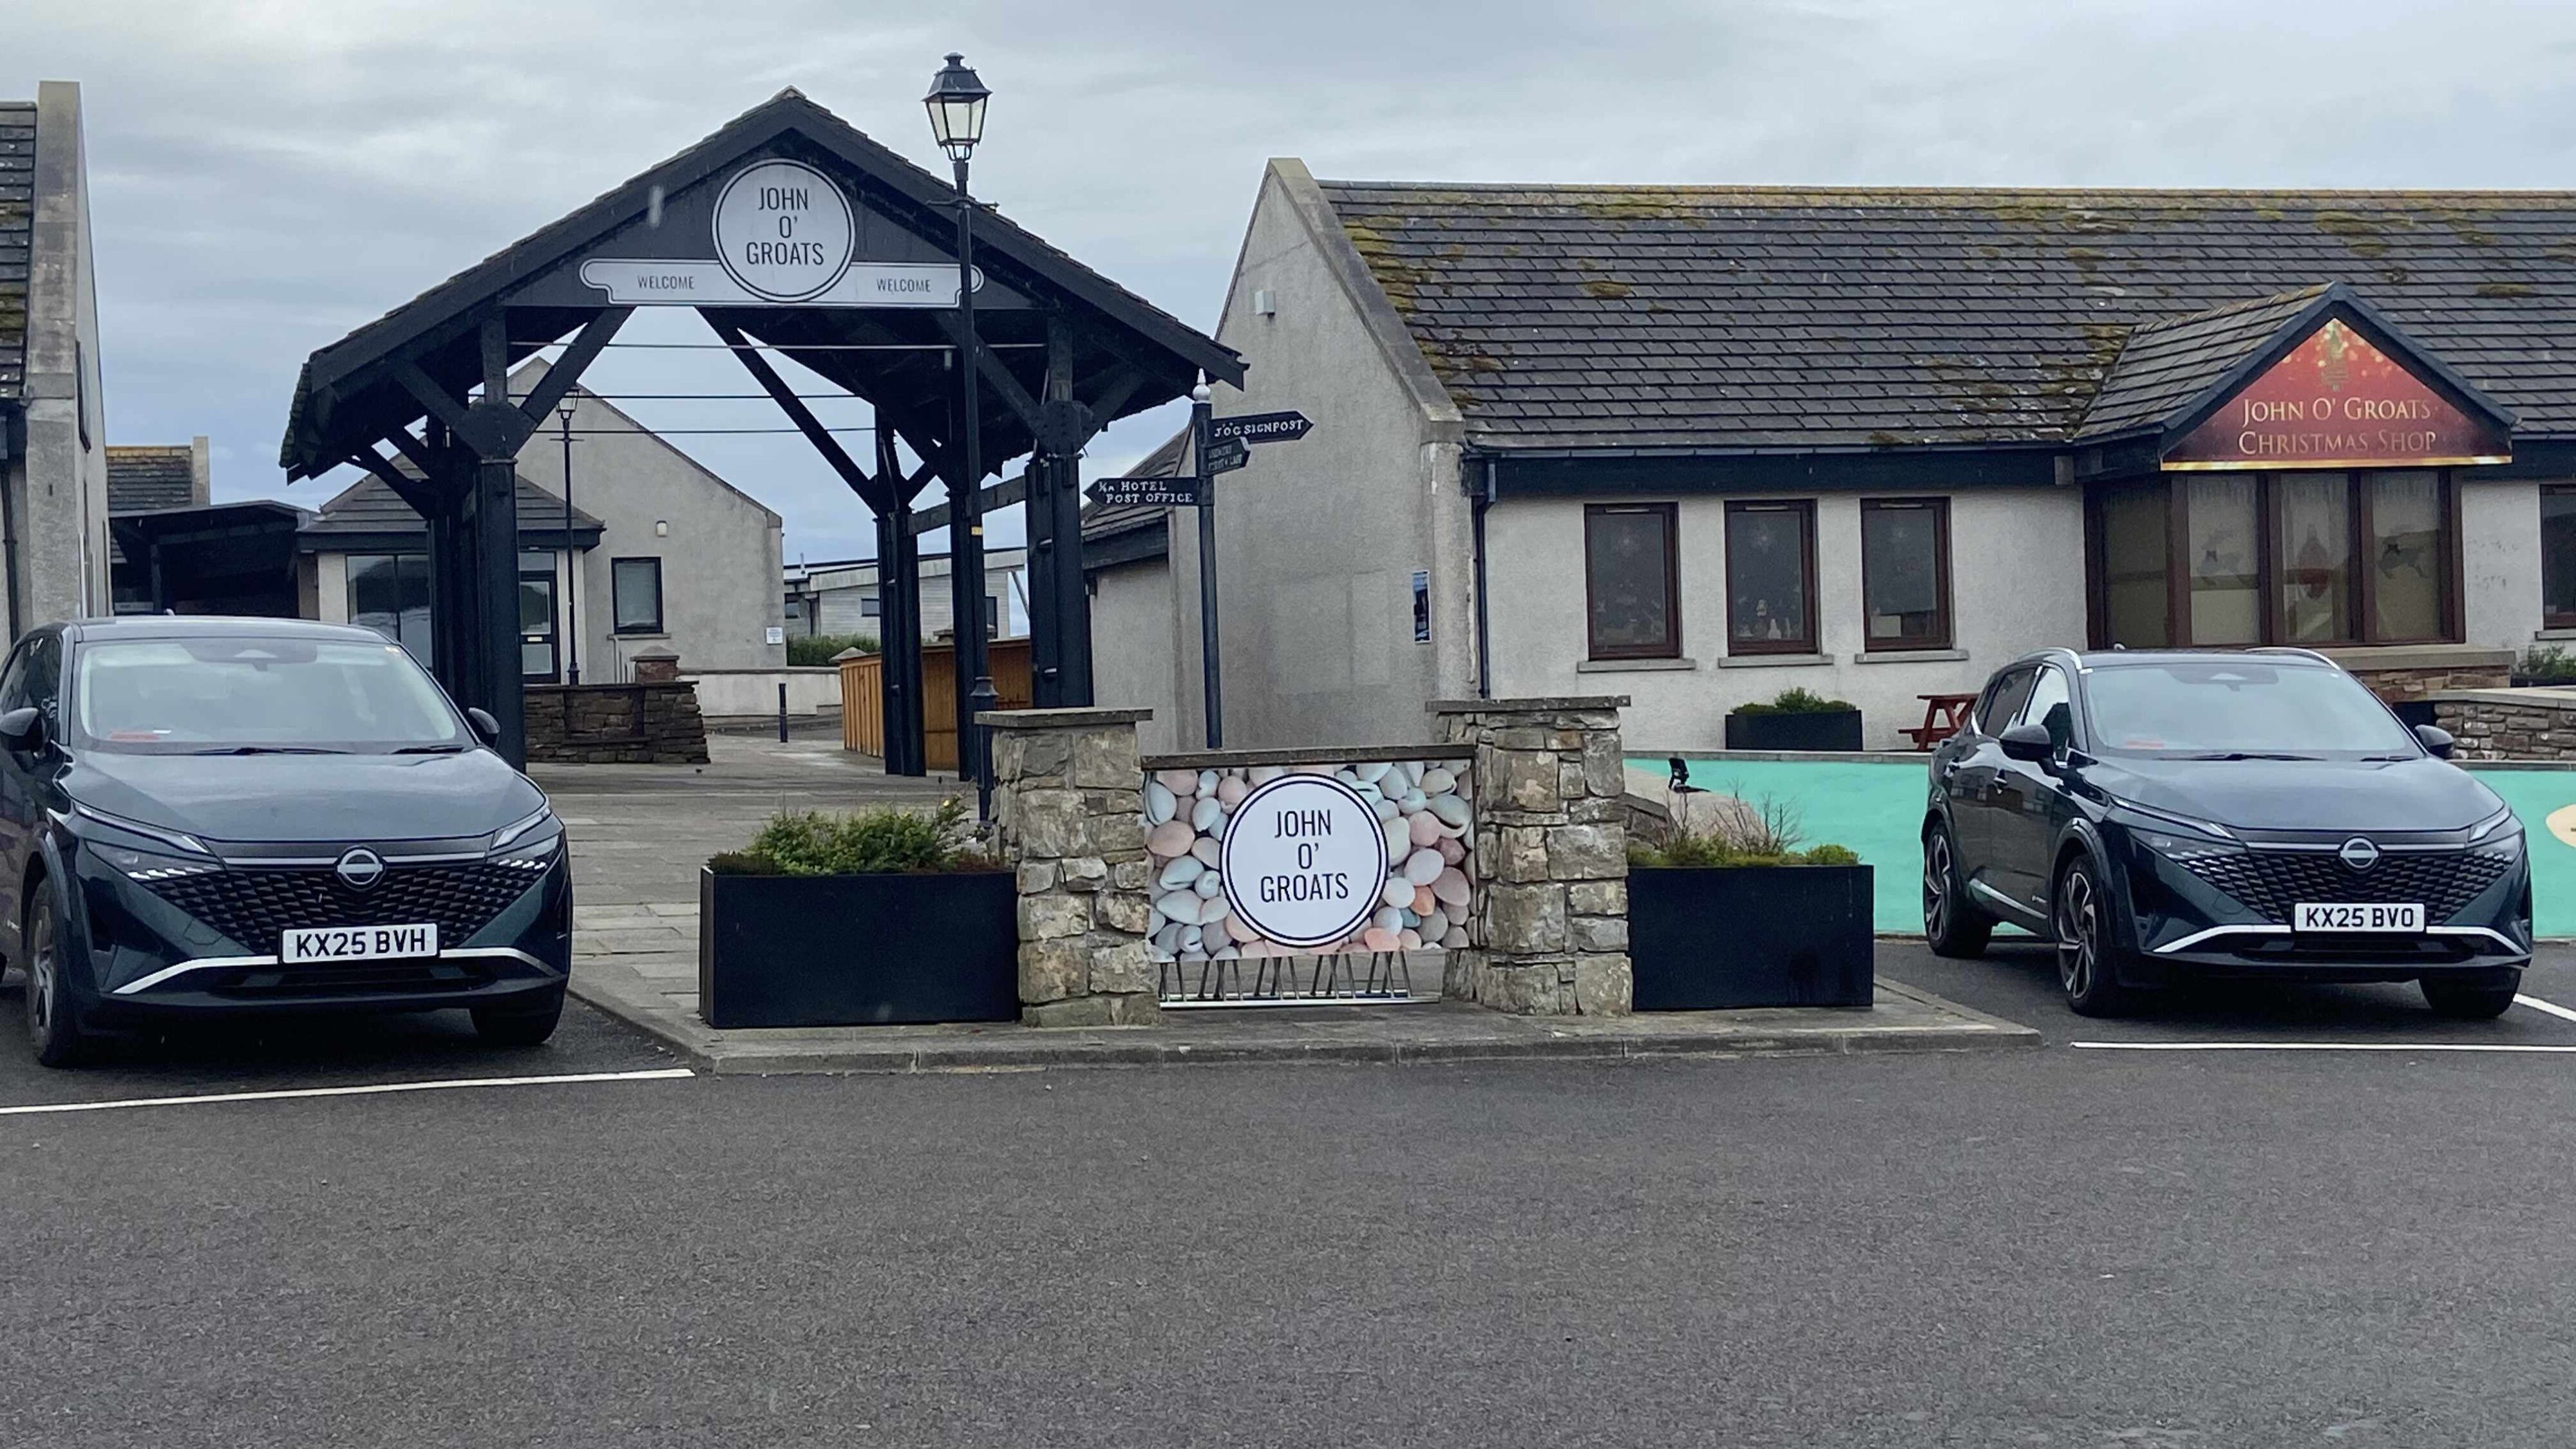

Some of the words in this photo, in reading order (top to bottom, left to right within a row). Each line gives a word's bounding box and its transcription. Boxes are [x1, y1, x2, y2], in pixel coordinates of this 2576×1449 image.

[759, 187, 808, 211] JOHN
[779, 215, 797, 238] O'
[746, 242, 824, 265] GROATS
[637, 275, 694, 289] WELCOME
[876, 278, 931, 292] WELCOME
[1244, 419, 1304, 435] SIGNPOST
[1121, 481, 1167, 492] HOTEL
[1106, 493, 1140, 504] POST
[1145, 493, 1193, 503] OFFICE
[1274, 809, 1332, 838] JOHN
[1298, 842, 1320, 869] O'
[1260, 872, 1349, 902] GROATS
[2306, 907, 2364, 927] KX25
[2372, 907, 2414, 927] BVO
[296, 931, 366, 958] KX25
[375, 928, 426, 954] BVH
